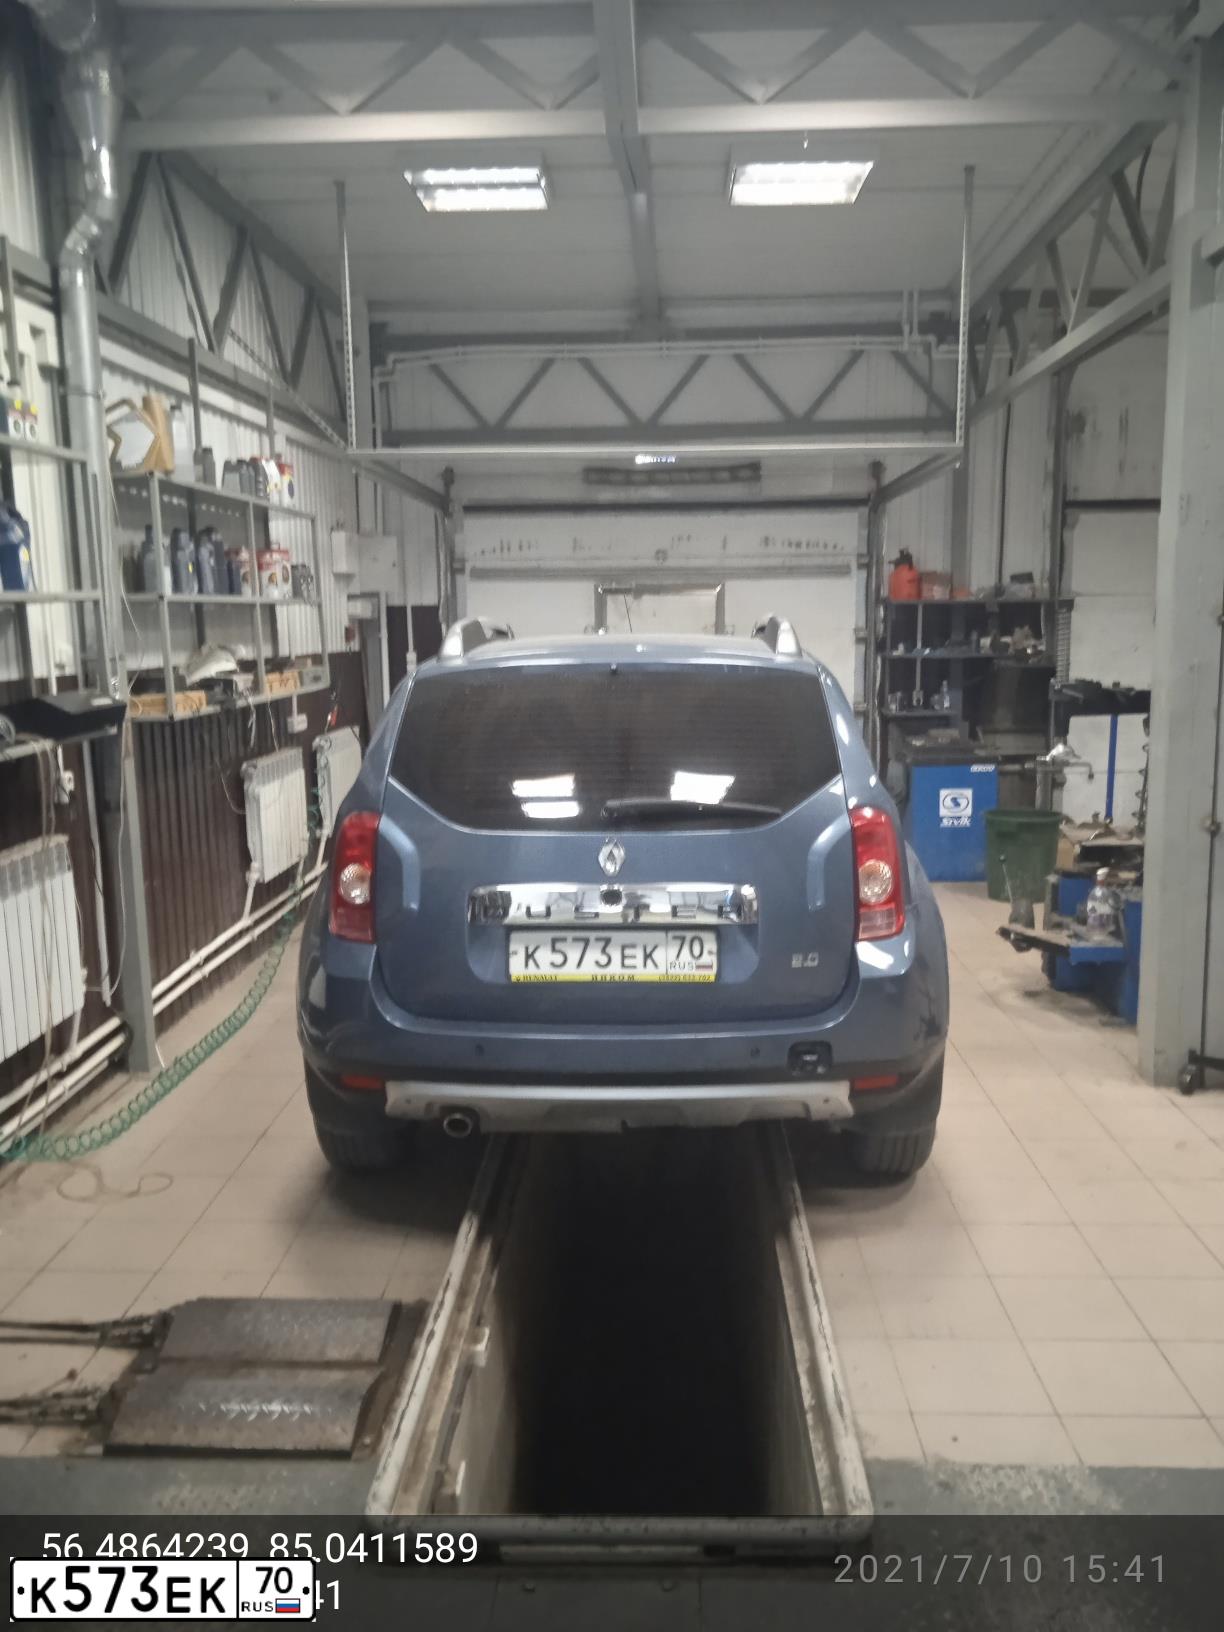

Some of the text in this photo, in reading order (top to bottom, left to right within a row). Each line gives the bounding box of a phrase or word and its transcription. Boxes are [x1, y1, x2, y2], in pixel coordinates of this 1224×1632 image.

[523, 934, 704, 970] K573EK 70
[669, 961, 694, 971] RUS
